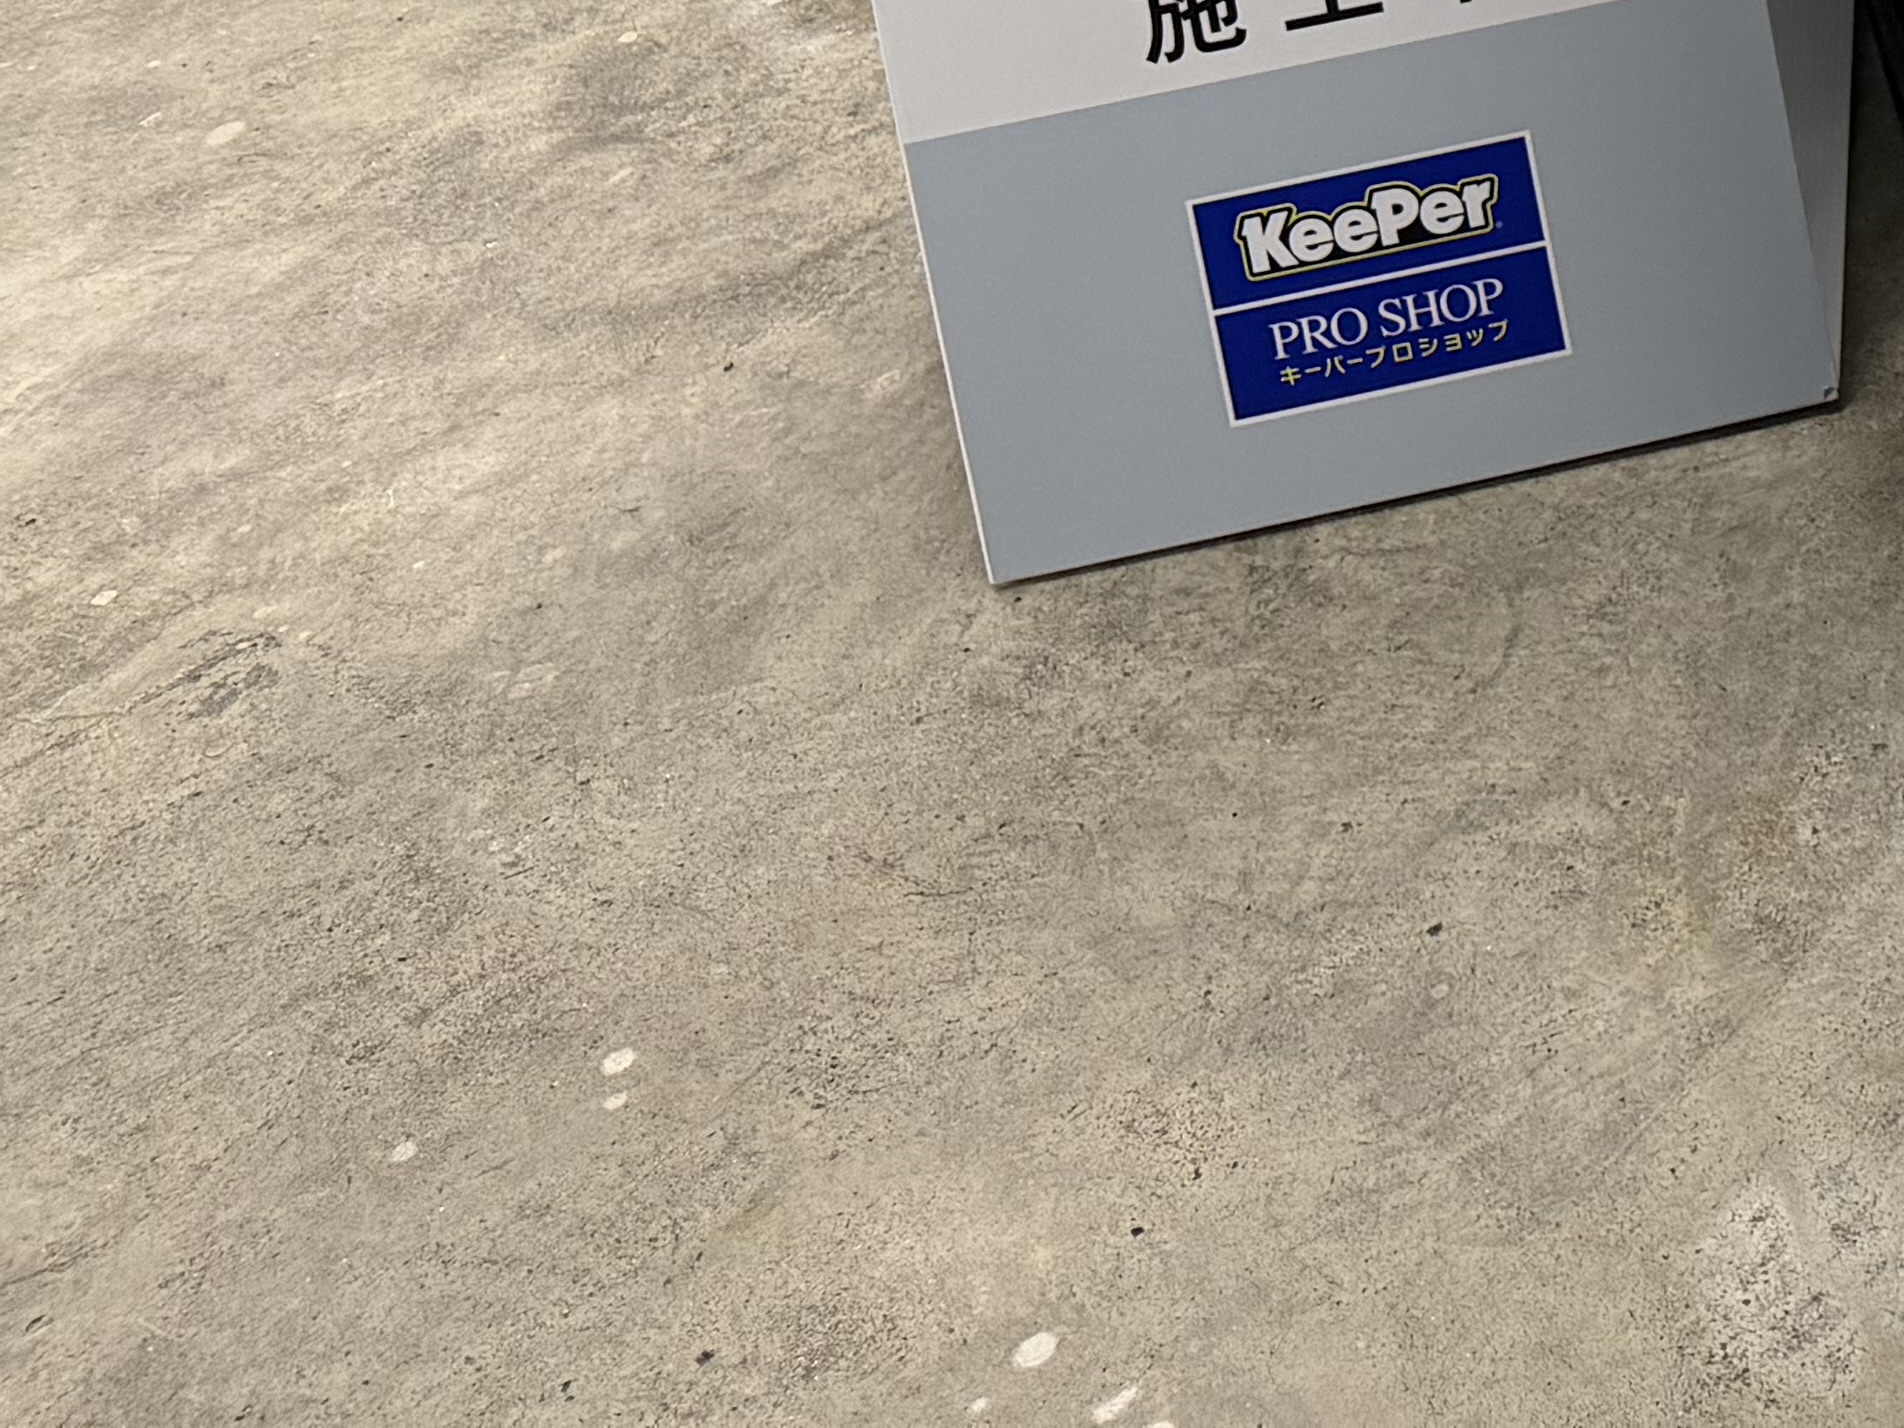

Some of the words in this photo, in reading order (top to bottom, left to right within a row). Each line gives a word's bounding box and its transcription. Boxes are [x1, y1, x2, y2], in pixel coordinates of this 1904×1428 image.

[1234, 173, 1499, 282] KeePer
[1268, 307, 1369, 361] PRO
[1378, 277, 1504, 337] SHOP
[1280, 319, 1509, 386] キーパープロショップ
